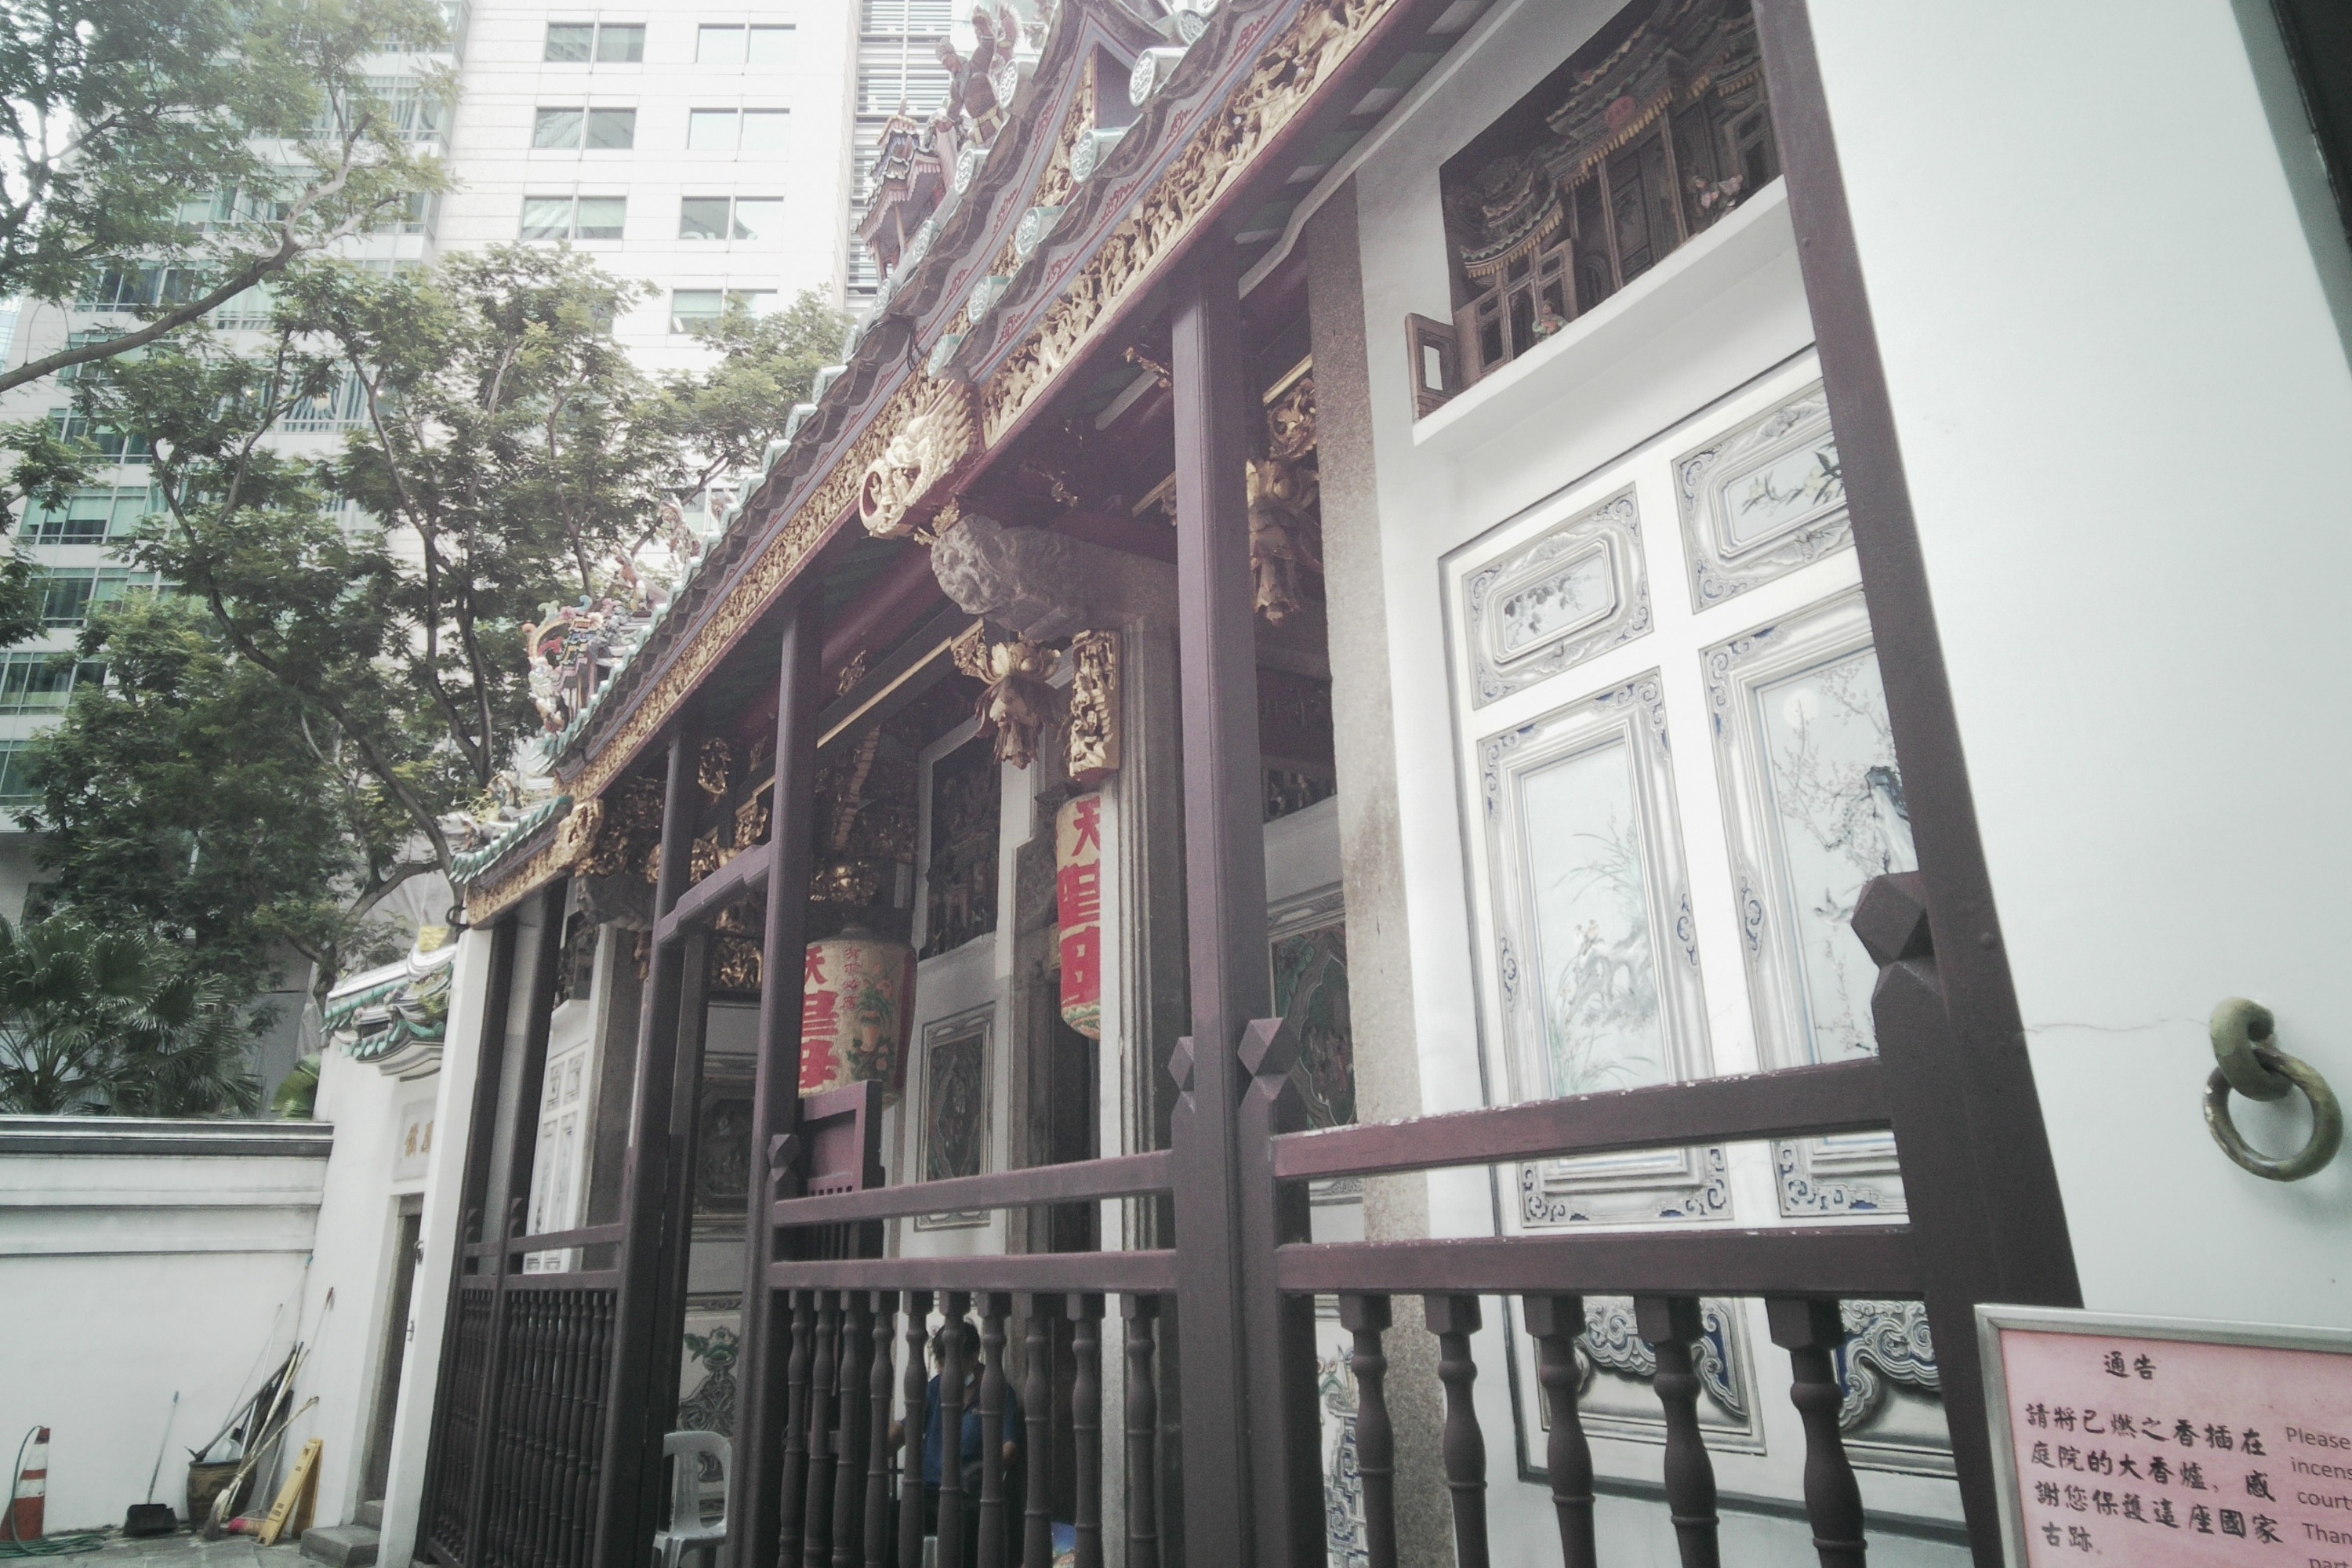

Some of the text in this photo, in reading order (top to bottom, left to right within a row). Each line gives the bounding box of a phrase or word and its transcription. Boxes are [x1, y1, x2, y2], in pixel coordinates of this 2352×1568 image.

[2103, 1351, 2157, 1380] 通告
[2285, 1427, 2351, 1450] Please
[2034, 1480, 2283, 1544] 謝您保護這座國家
[2297, 1491, 2352, 1511] court
[2302, 1523, 2352, 1544] Than
